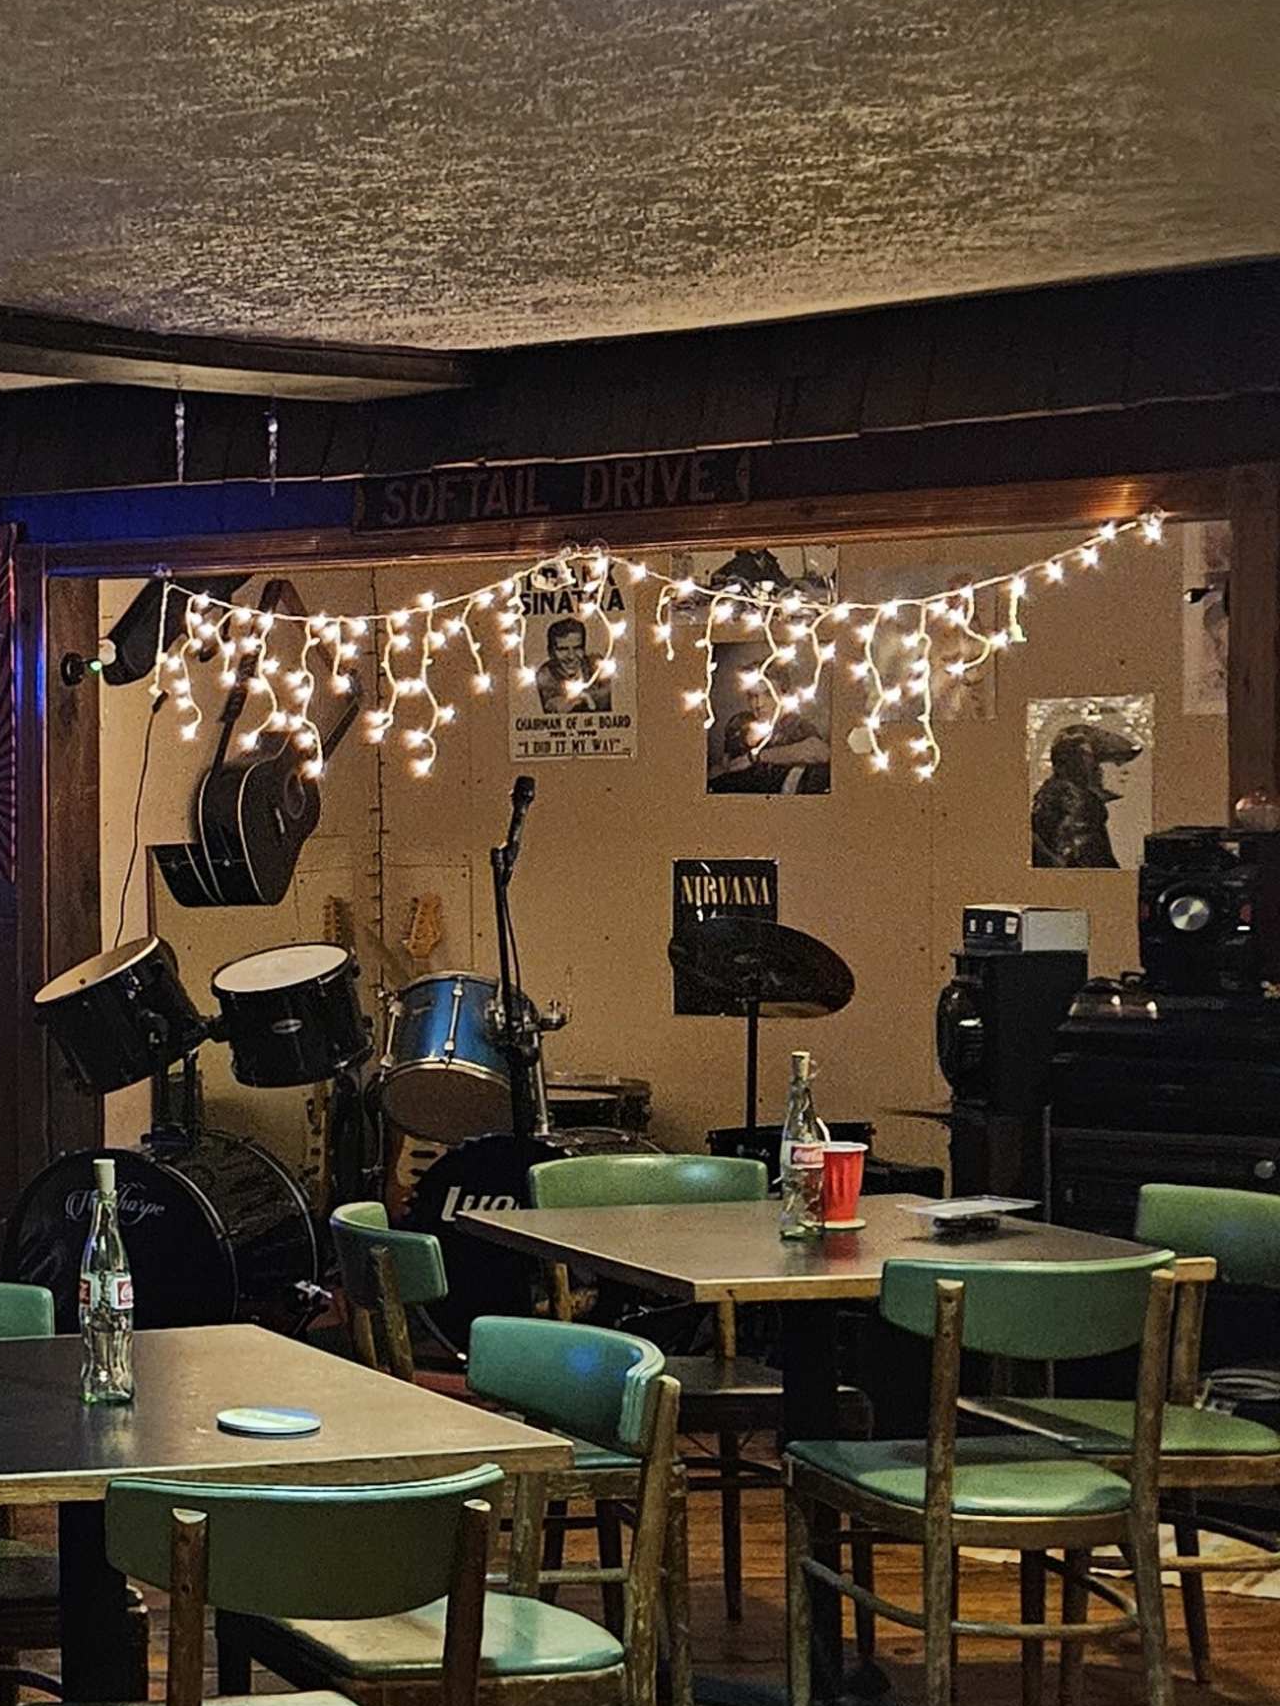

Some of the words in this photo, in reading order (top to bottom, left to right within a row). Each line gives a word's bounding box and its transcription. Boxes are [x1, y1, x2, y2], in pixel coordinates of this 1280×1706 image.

[381, 465, 550, 525] SOFTAIL
[582, 453, 716, 510] DRIVE
[524, 560, 617, 592] FRAK
[520, 588, 625, 615] SINATA
[515, 717, 562, 731] CHAIRMAN
[566, 716, 579, 729] OF
[599, 714, 631, 729] BOARD
[680, 875, 770, 905] NIRVANA
